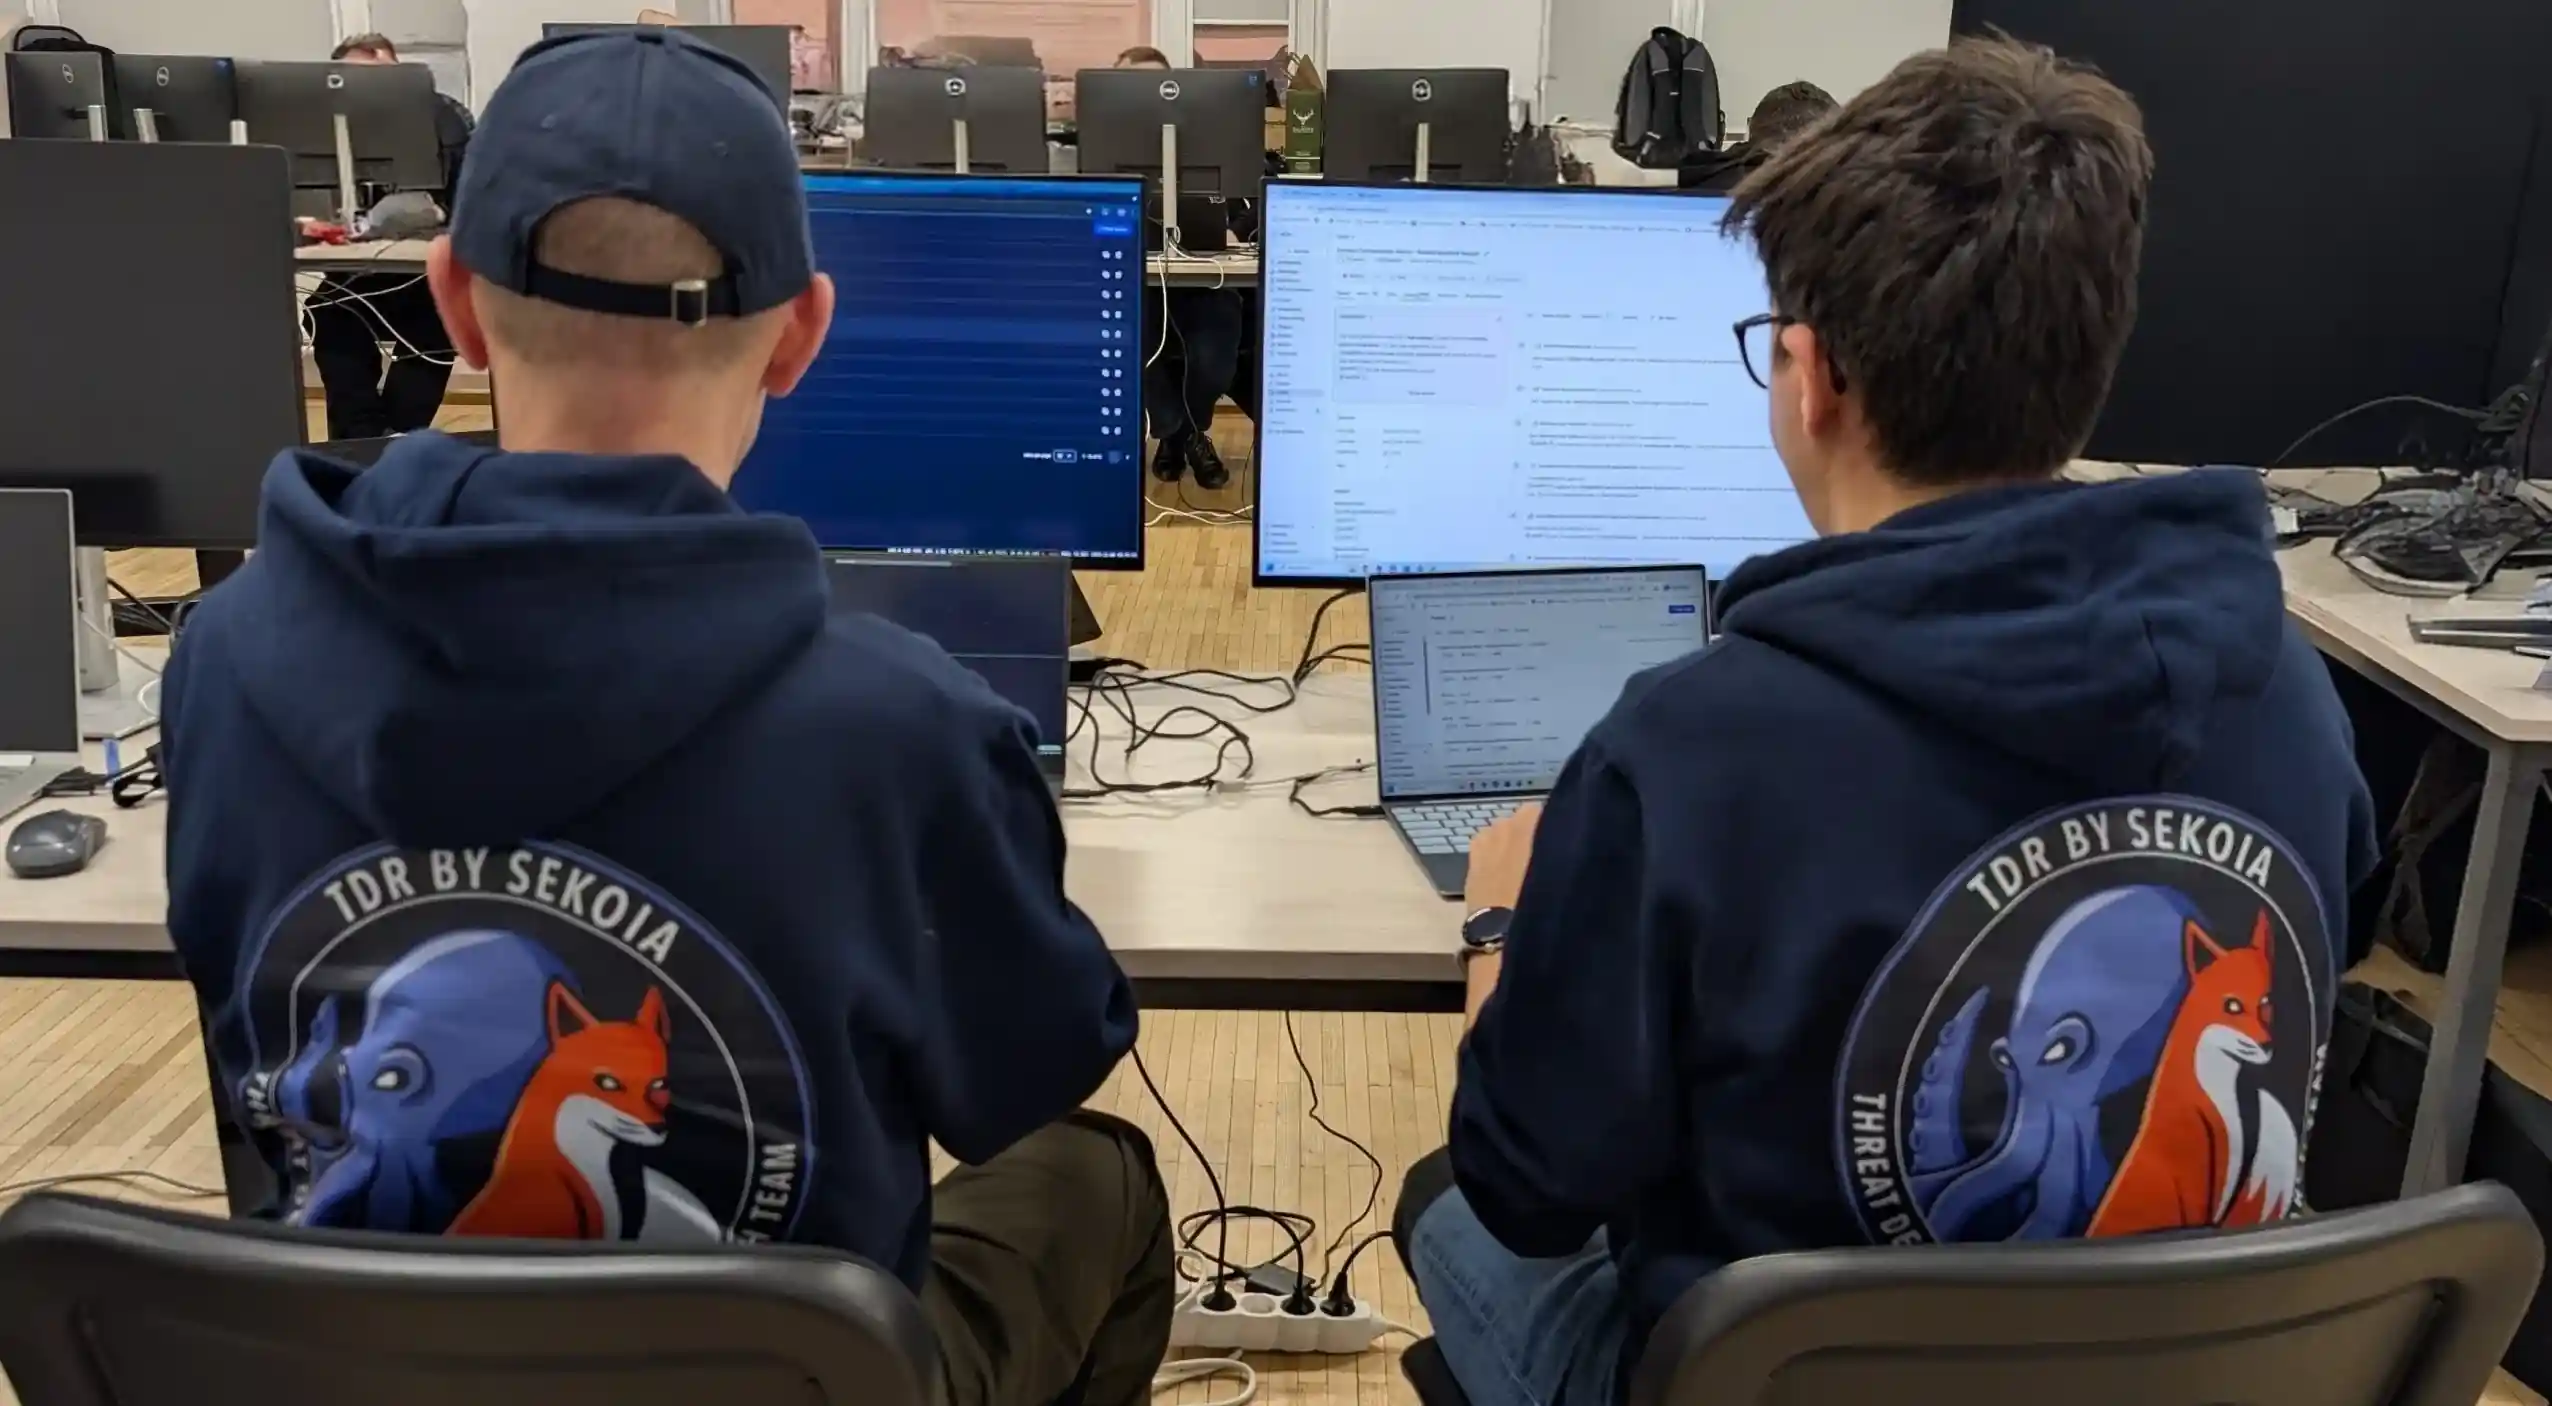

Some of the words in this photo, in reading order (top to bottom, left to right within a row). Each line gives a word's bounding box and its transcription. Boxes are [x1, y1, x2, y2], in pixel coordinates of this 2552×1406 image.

[323, 857, 416, 923] TDR
[430, 846, 489, 891] BY
[505, 849, 680, 965] SEKOIA
[1966, 836, 2053, 911] TDR
[2061, 810, 2110, 861] BY
[2127, 807, 2273, 888] SEKOIA
[749, 1143, 796, 1222] TEAM
[1852, 1093, 1901, 1209] THREAT
